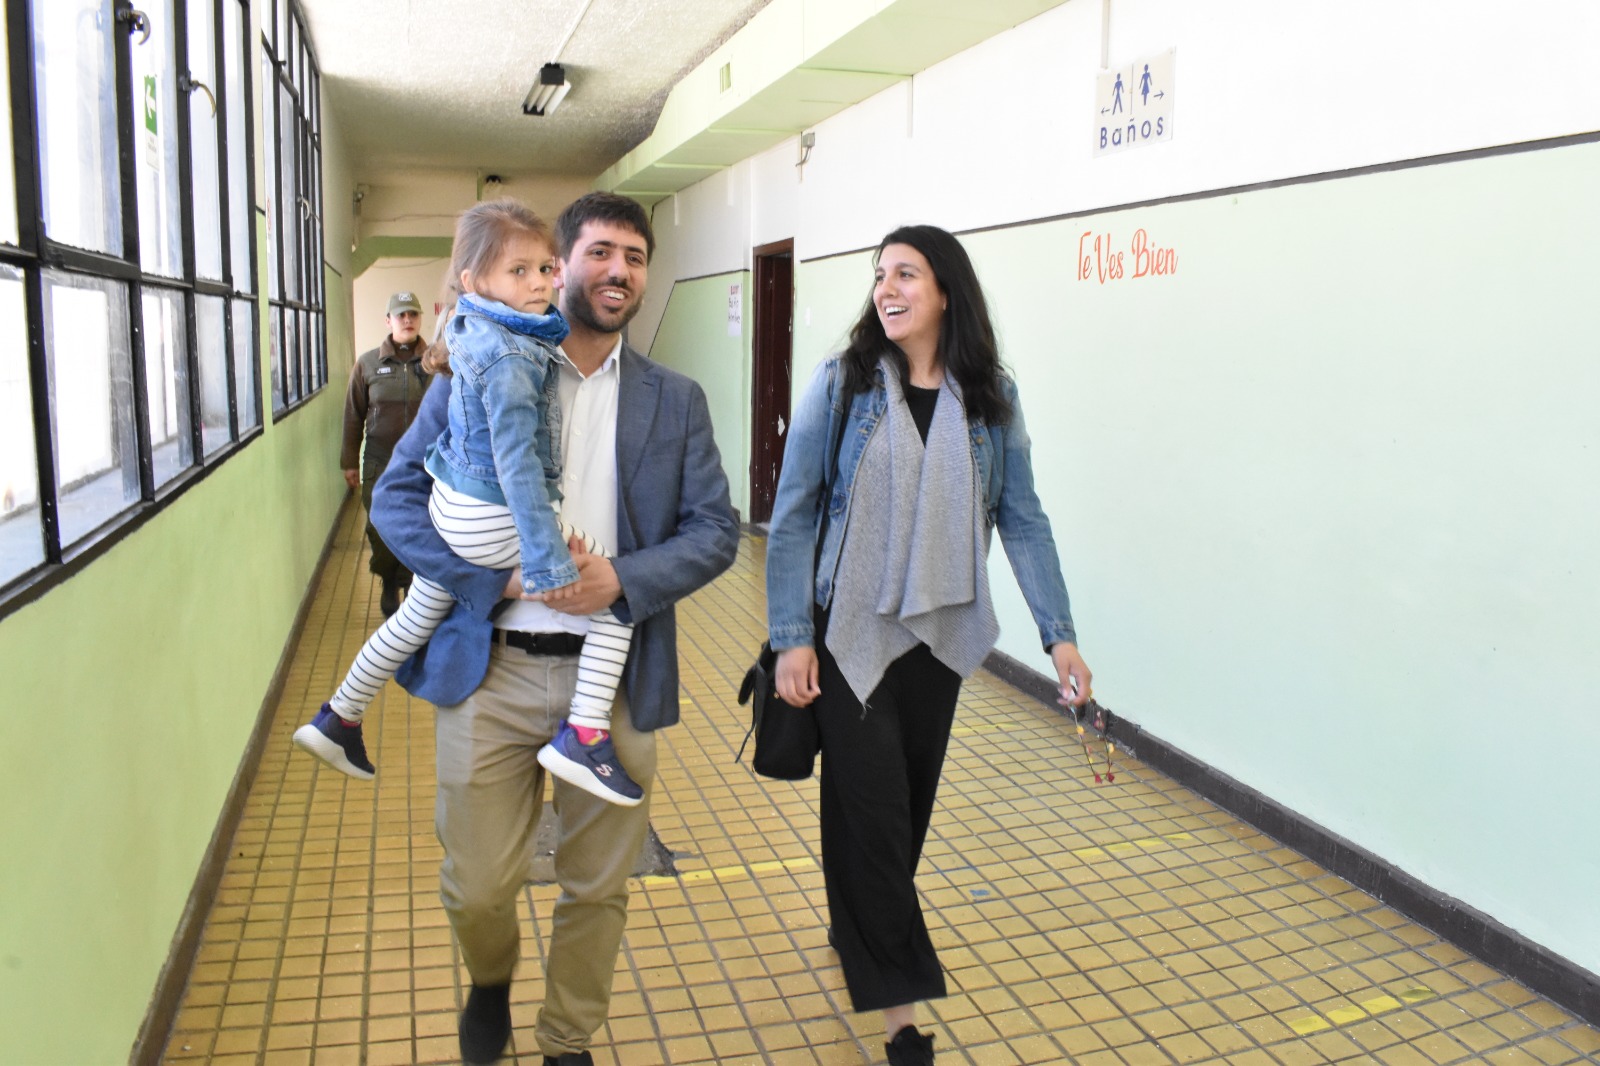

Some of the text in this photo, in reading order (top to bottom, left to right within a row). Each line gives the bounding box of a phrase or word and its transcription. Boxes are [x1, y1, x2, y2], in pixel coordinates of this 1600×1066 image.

[1100, 116, 1163, 149] Baños
[1077, 228, 1178, 284] Te Ves Bien
